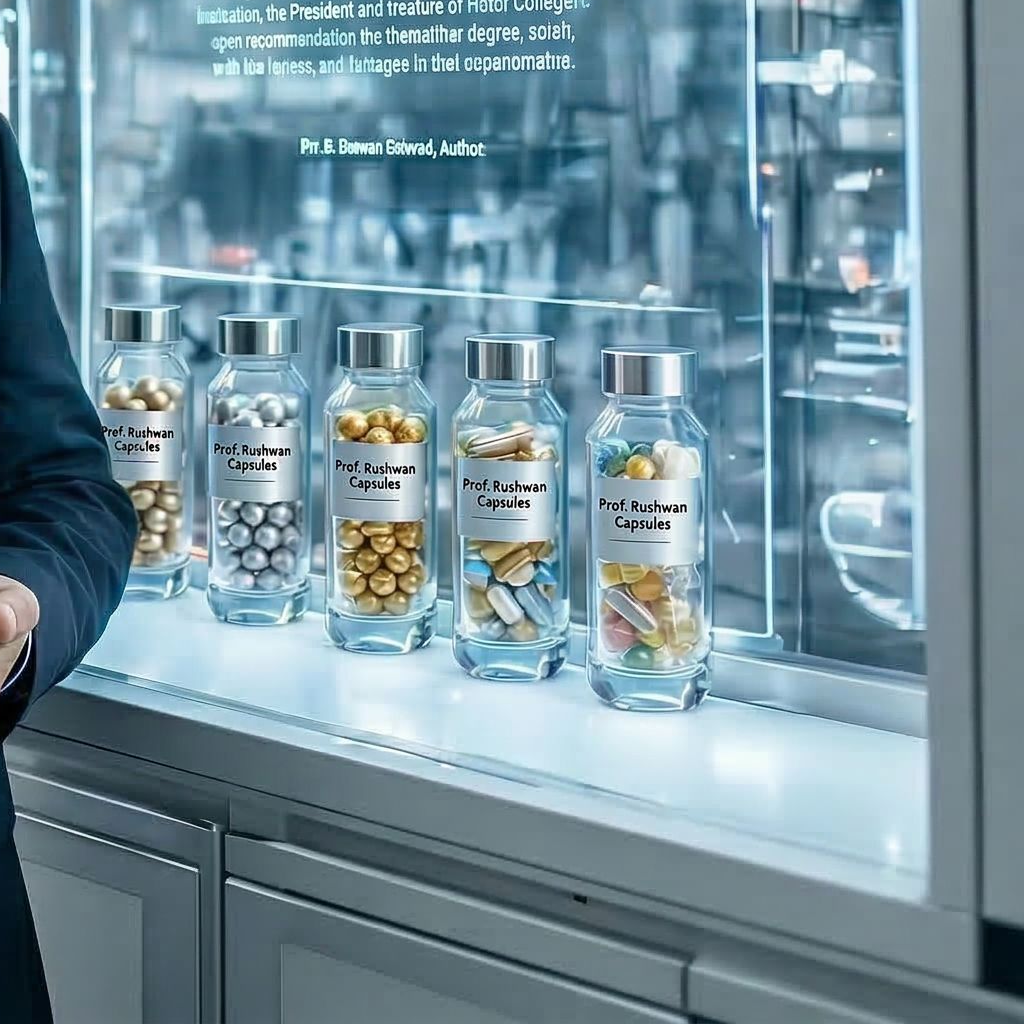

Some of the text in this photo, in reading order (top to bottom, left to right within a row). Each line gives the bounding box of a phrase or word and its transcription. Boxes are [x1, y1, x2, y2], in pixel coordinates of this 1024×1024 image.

[266, 3, 287, 22] the
[290, 0, 354, 20] President
[360, 26, 382, 45] the
[468, 23, 524, 47] degree,
[319, 54, 344, 74] and
[128, 426, 174, 439] Rushwan
[214, 443, 291, 457] Prof. Rushwan
[227, 458, 277, 474] Capsules
[335, 459, 416, 475] Prof. Rushwan
[349, 476, 401, 493] Capsules
[462, 478, 547, 493] Prof. Rushwan
[599, 498, 688, 514] Prof. Rushwan
[614, 516, 671, 534] Capsules
